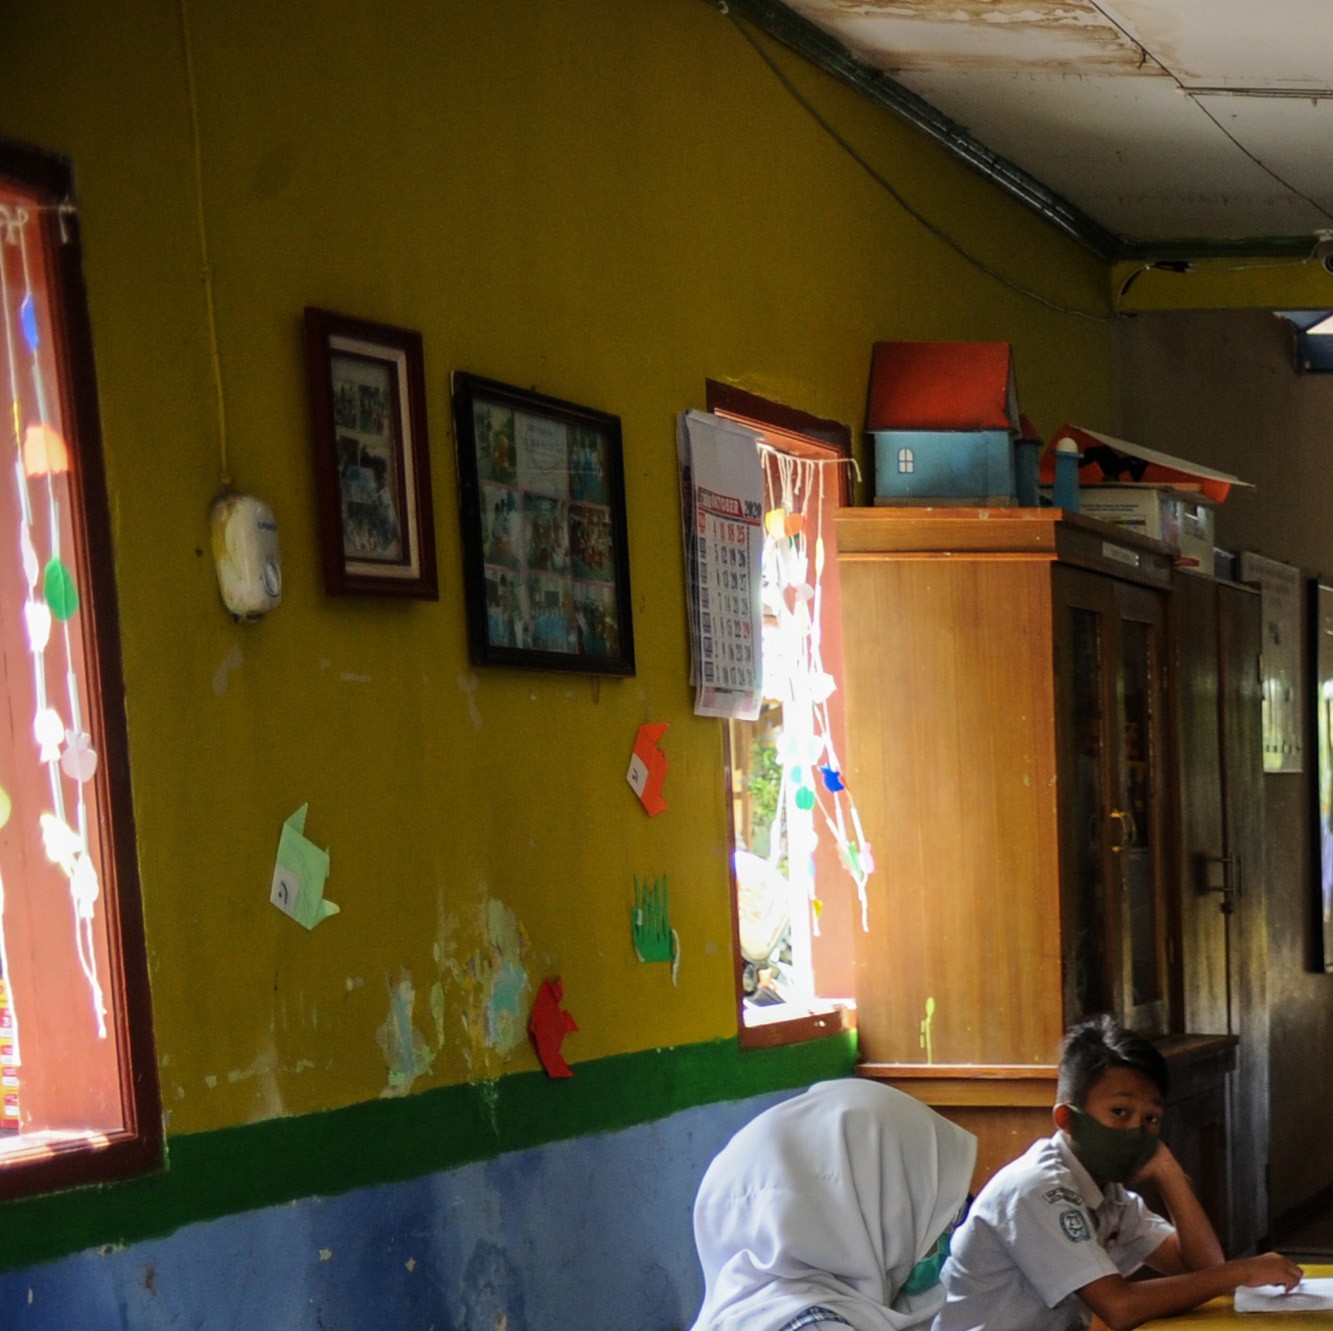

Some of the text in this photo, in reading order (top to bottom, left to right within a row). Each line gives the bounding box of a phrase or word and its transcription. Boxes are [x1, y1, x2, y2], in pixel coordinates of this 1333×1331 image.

[711, 495, 761, 518] OKTOBER 2020
[727, 524, 734, 543] 18
[737, 525, 745, 544] 25
[721, 545, 727, 564] 12
[729, 548, 736, 566] 19
[738, 549, 746, 568] 26
[730, 571, 737, 590] 20
[739, 573, 747, 591] 27
[734, 620, 741, 639] 22
[743, 620, 751, 640] 29
[735, 643, 743, 662] 23
